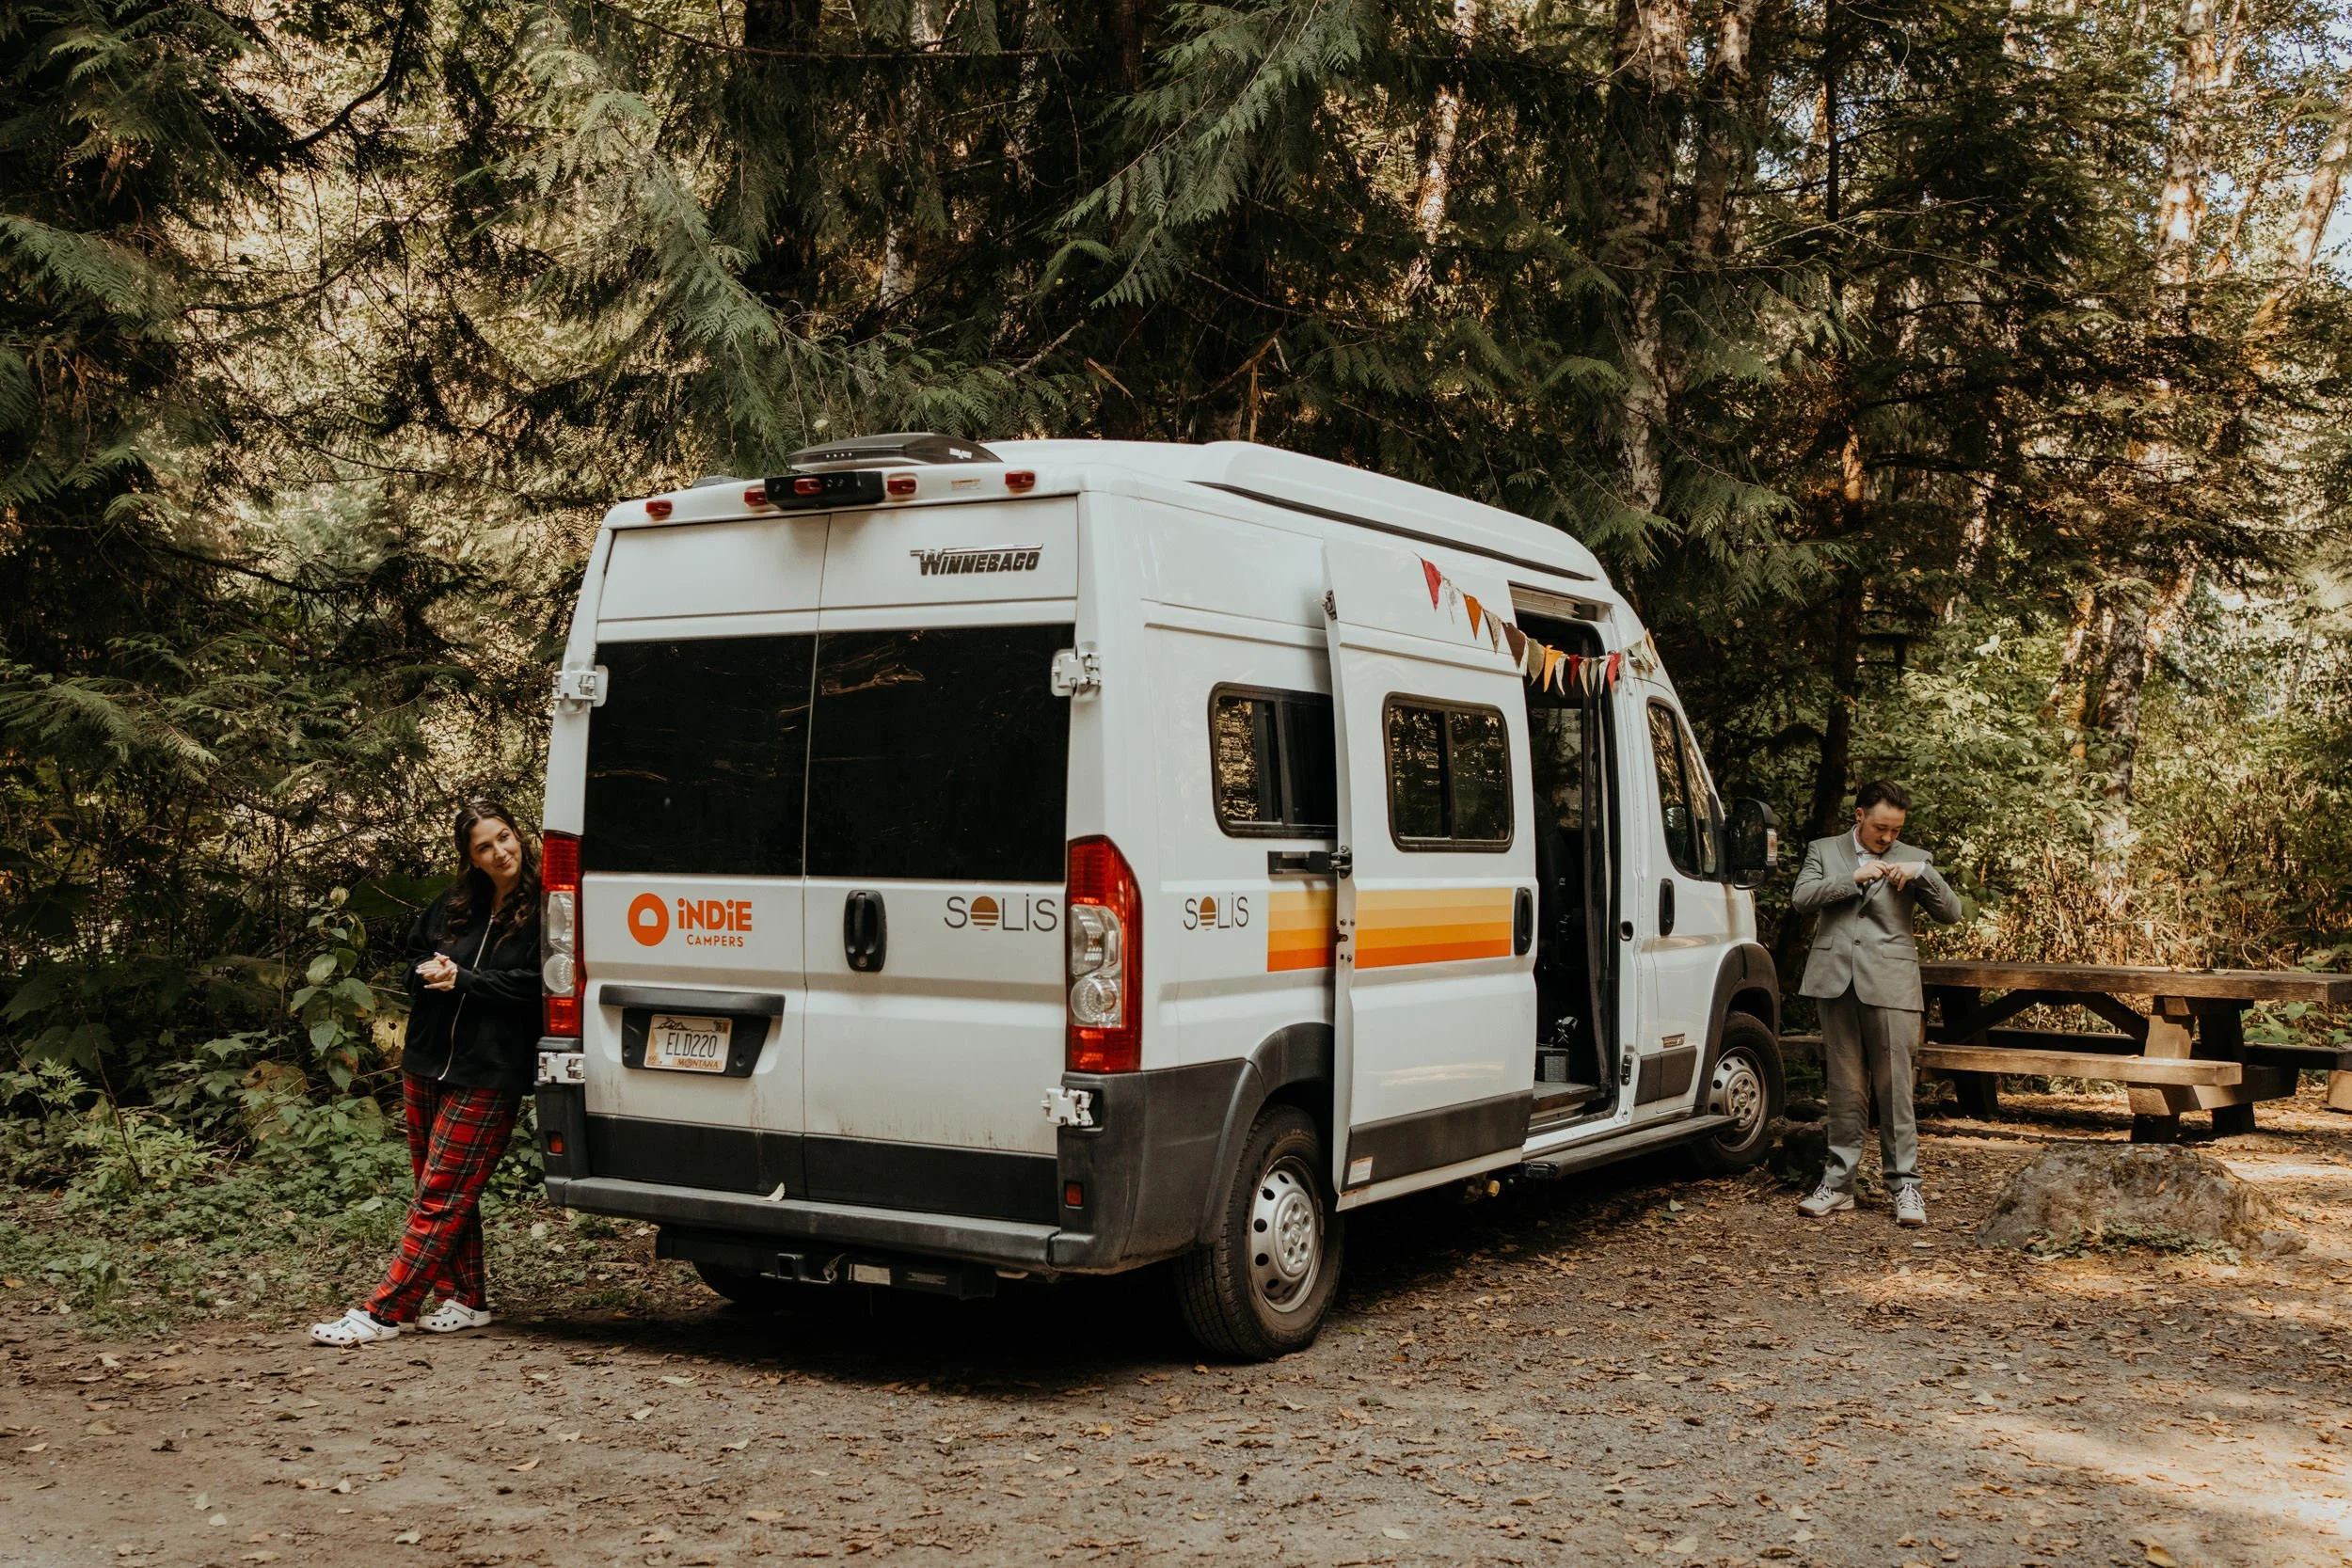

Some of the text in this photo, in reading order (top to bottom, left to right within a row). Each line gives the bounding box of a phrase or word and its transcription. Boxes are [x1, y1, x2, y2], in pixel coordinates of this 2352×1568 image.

[912, 546, 1042, 576] WINNEBAGO
[686, 934, 744, 947] CAMPERS
[666, 1032, 718, 1058] ELD220
[676, 1058, 719, 1069] MONTANA
